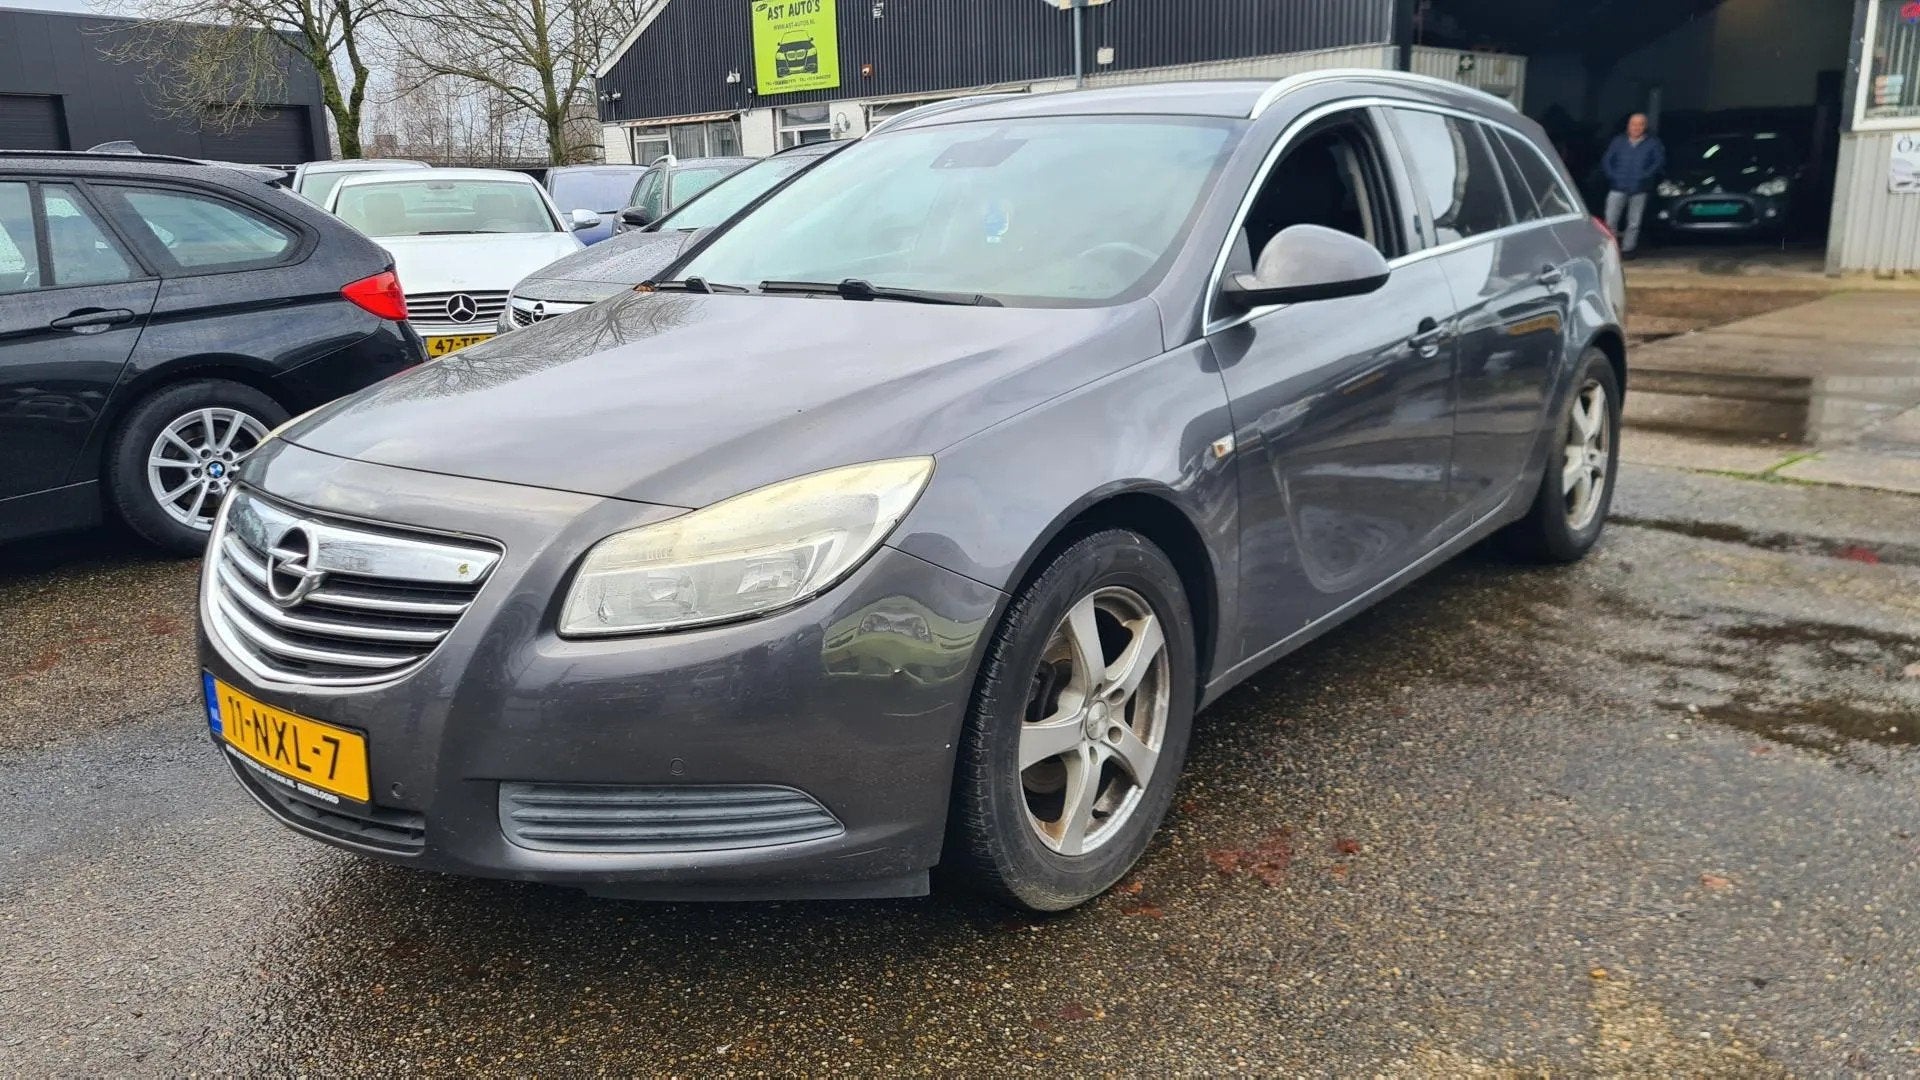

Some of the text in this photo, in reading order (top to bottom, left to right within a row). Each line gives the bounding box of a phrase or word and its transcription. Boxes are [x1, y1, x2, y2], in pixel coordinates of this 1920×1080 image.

[767, 0, 821, 21] AST AUTO'S
[228, 696, 340, 780] 11-NXL-7
